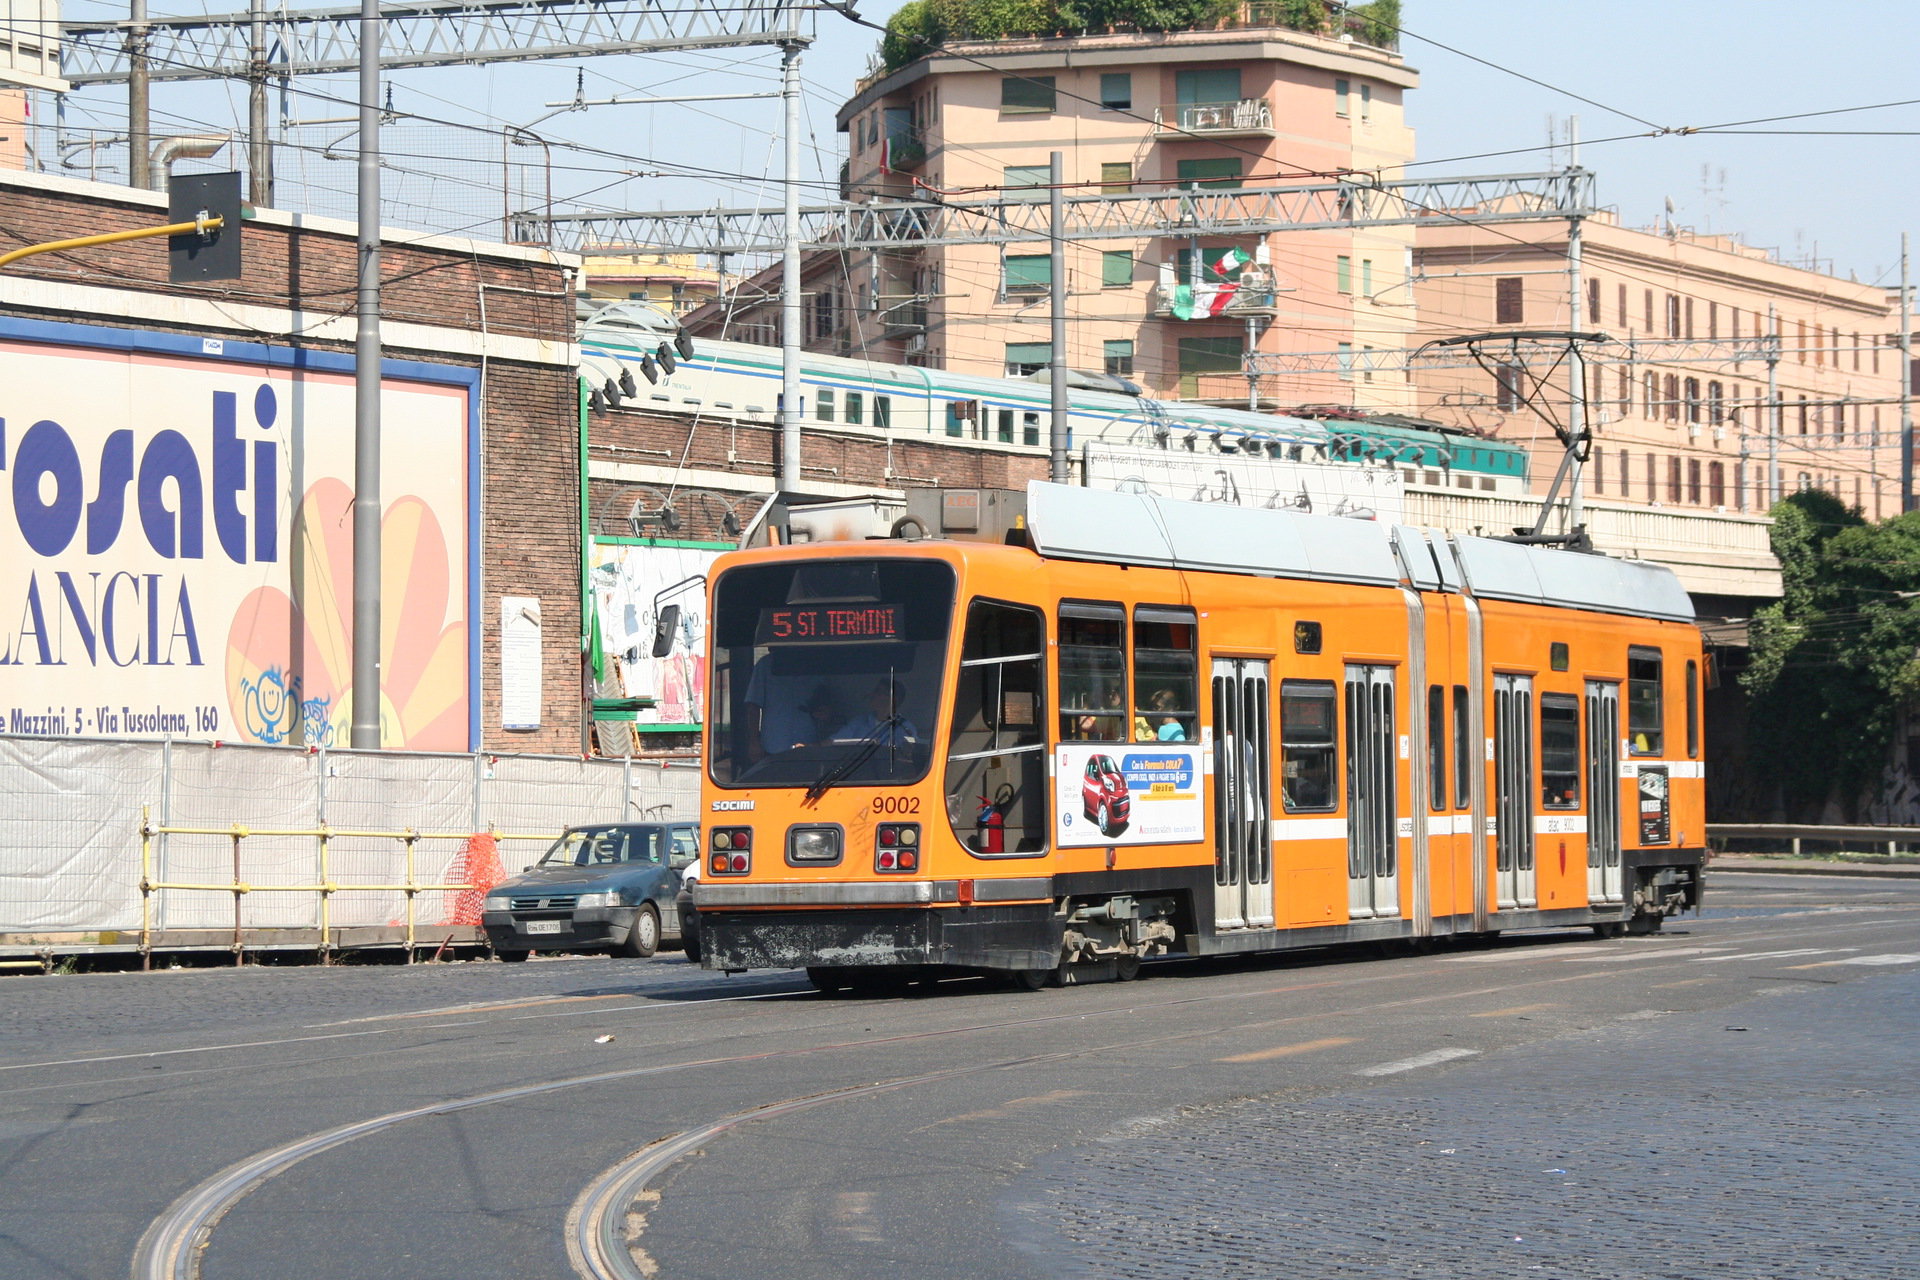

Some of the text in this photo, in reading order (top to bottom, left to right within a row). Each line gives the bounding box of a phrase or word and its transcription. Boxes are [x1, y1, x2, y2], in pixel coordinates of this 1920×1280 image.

[0, 384, 277, 565] osati
[772, 611, 793, 637] 5
[10, 706, 70, 736] Mazzini,
[74, 707, 83, 735] 5
[96, 705, 119, 733] Via
[122, 705, 190, 738] Tuscolana,
[195, 706, 219, 733] 160
[872, 796, 920, 814] 9002
